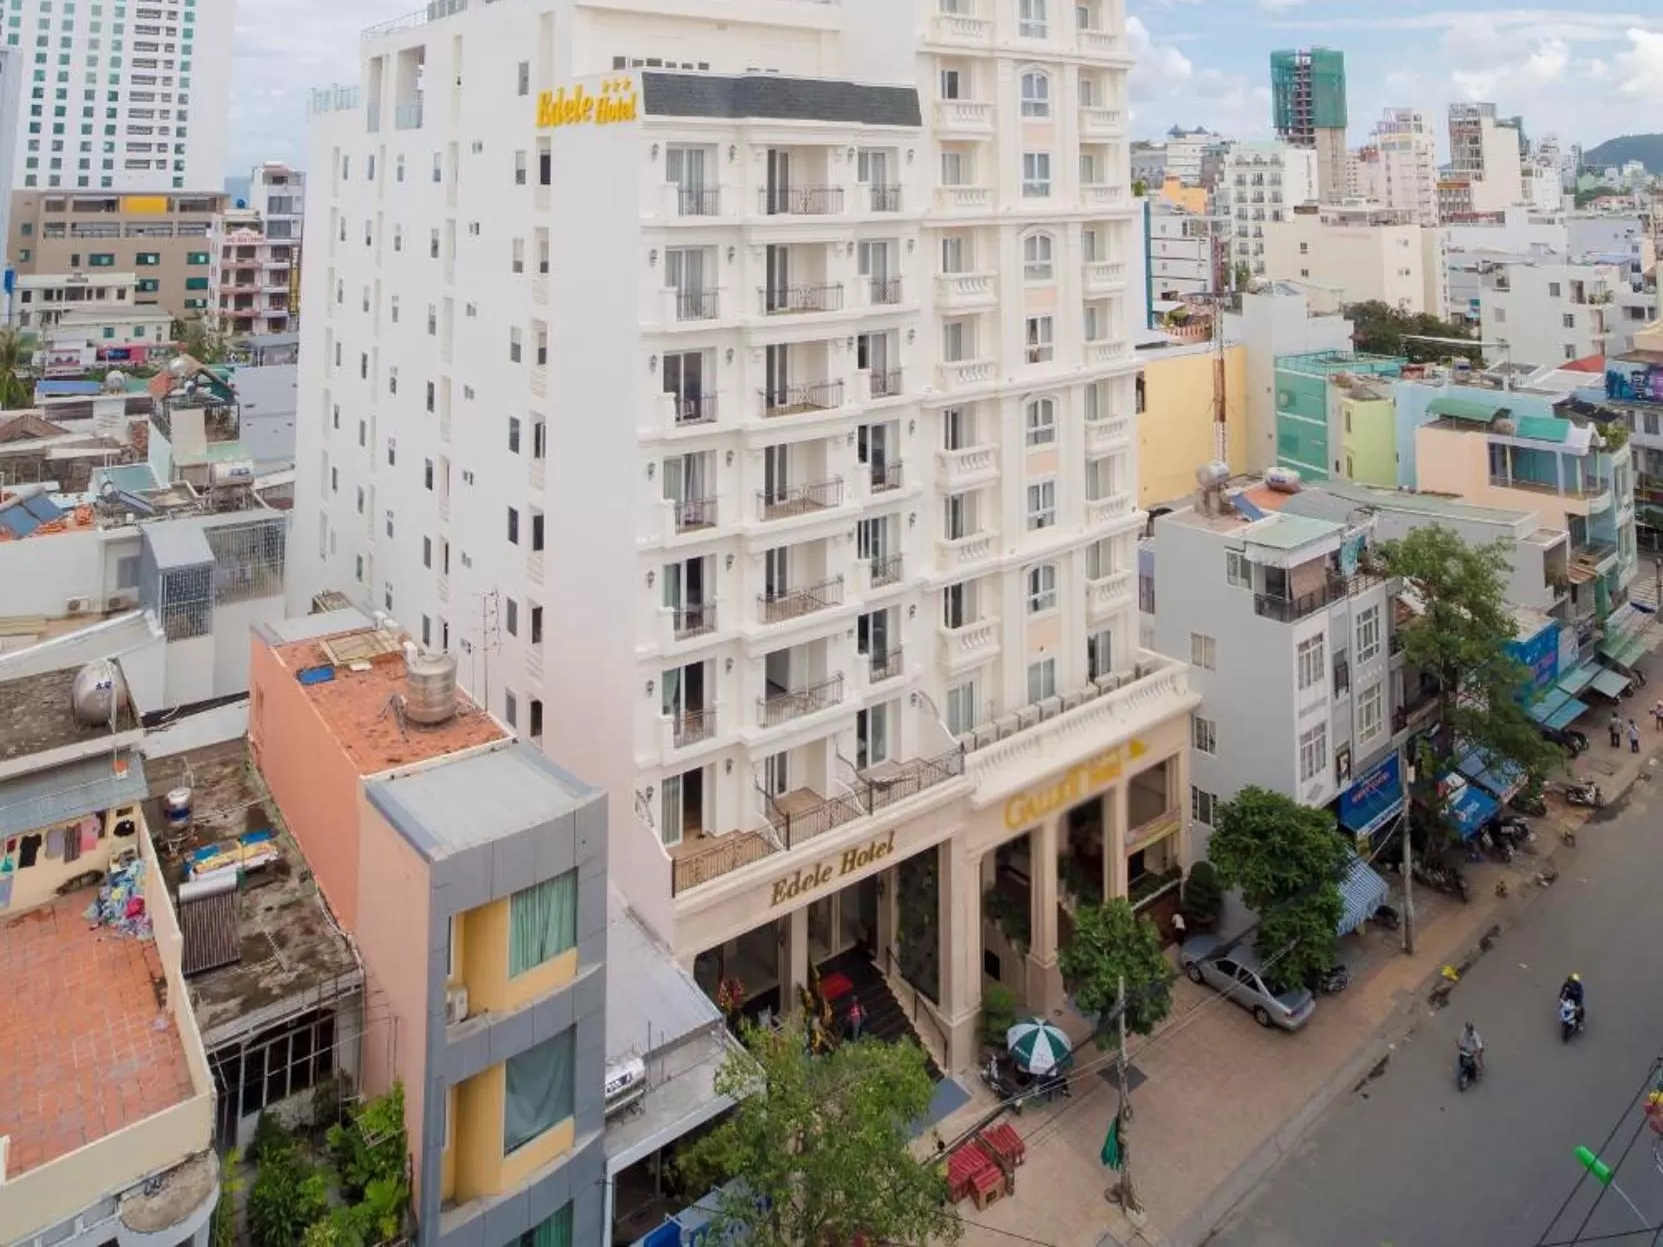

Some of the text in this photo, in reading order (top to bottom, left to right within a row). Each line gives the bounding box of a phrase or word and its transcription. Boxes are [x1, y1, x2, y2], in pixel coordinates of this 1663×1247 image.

[536, 83, 637, 128] Edele Hotel
[769, 828, 896, 908] Edele Hotel
